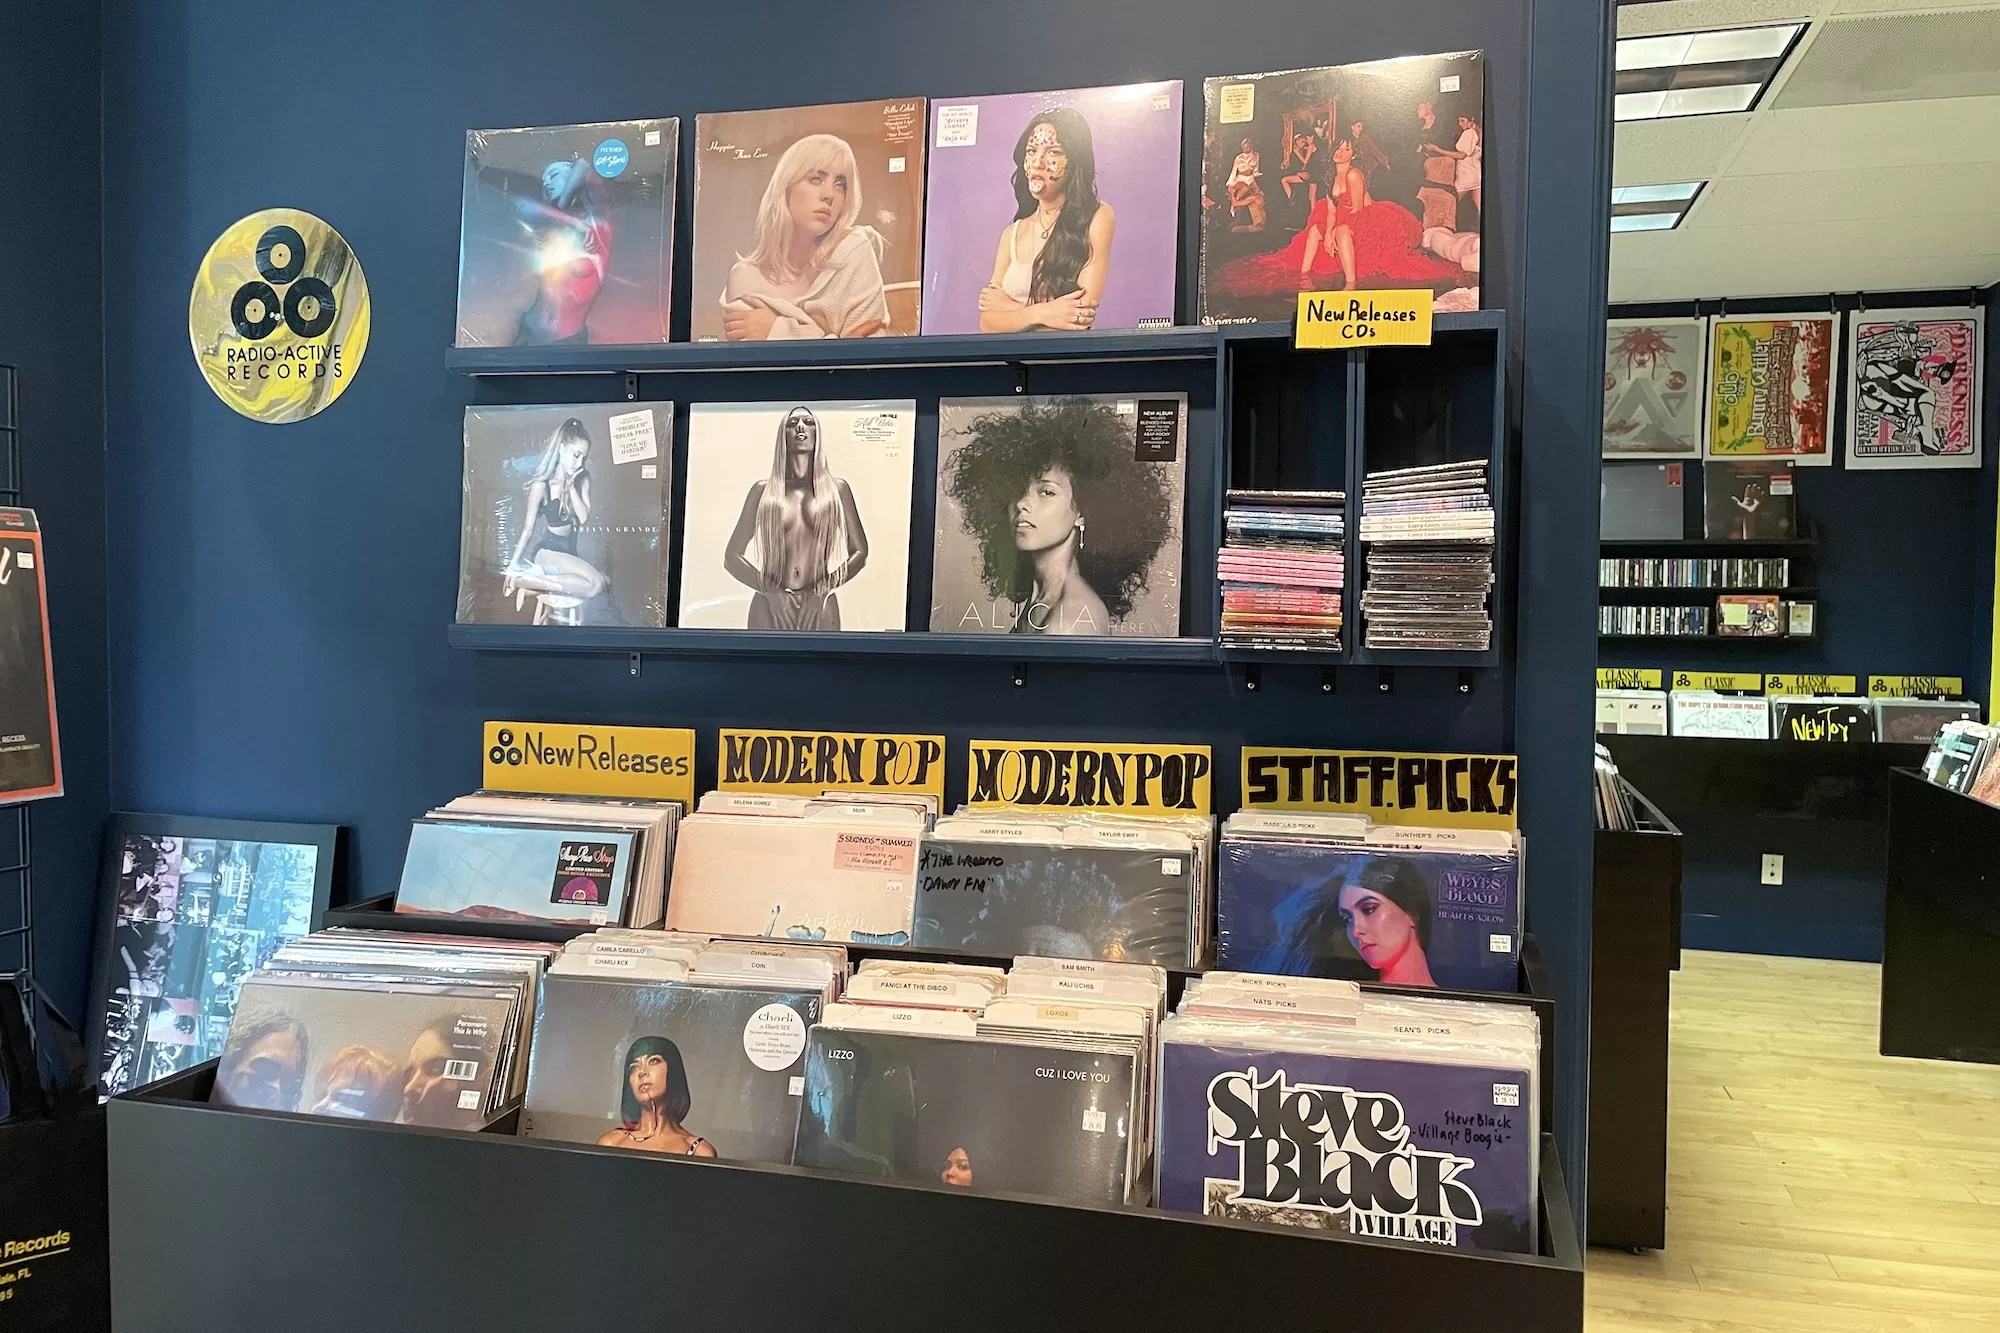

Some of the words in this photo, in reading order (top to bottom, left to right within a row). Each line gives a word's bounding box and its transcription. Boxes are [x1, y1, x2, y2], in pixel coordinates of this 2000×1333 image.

[1348, 299, 1416, 322] Releases
[1341, 324, 1376, 339] CDs
[227, 345, 341, 363] RADIO-ACTIVE
[227, 361, 342, 380] RECORDS
[1947, 333, 1968, 443] DARKNESS
[959, 602, 1097, 631] ALICIA
[1107, 622, 1145, 633] HERE
[1605, 669, 1642, 680] CLASSIC
[1704, 676, 1735, 688] CLASSIC
[524, 732, 574, 767] New
[578, 734, 689, 776] Releases
[723, 735, 867, 784] MODERN
[869, 738, 941, 785] POP
[970, 749, 1136, 806] MODERN
[1131, 753, 1209, 809] POP
[880, 838, 913, 848] SUMMER
[1446, 872, 1501, 892] WEYES
[1447, 887, 1498, 905] BLOOD
[1438, 910, 1474, 920] HEARTS
[595, 958, 616, 966] CHARLI
[1058, 981, 1073, 989] KALI
[1253, 998, 1272, 1006] NATS
[758, 1011, 794, 1023] Charli
[893, 1013, 912, 1022] LIZZO
[453, 1026, 465, 1035] This
[472, 1029, 488, 1038] Why
[1394, 1026, 1422, 1034] SEAN'S
[828, 1049, 855, 1060] LIZZO
[1035, 1067, 1055, 1079] CUZ
[1056, 1069, 1061, 1079] I
[1062, 1070, 1087, 1081] LOVE
[1089, 1072, 1111, 1083] YOU
[1207, 1067, 1410, 1156] Steve
[1476, 1113, 1512, 1129] Black
[1226, 1137, 1484, 1226] Black
[1356, 1212, 1456, 1245] VILLAGE
[4, 1229, 71, 1258] Records
